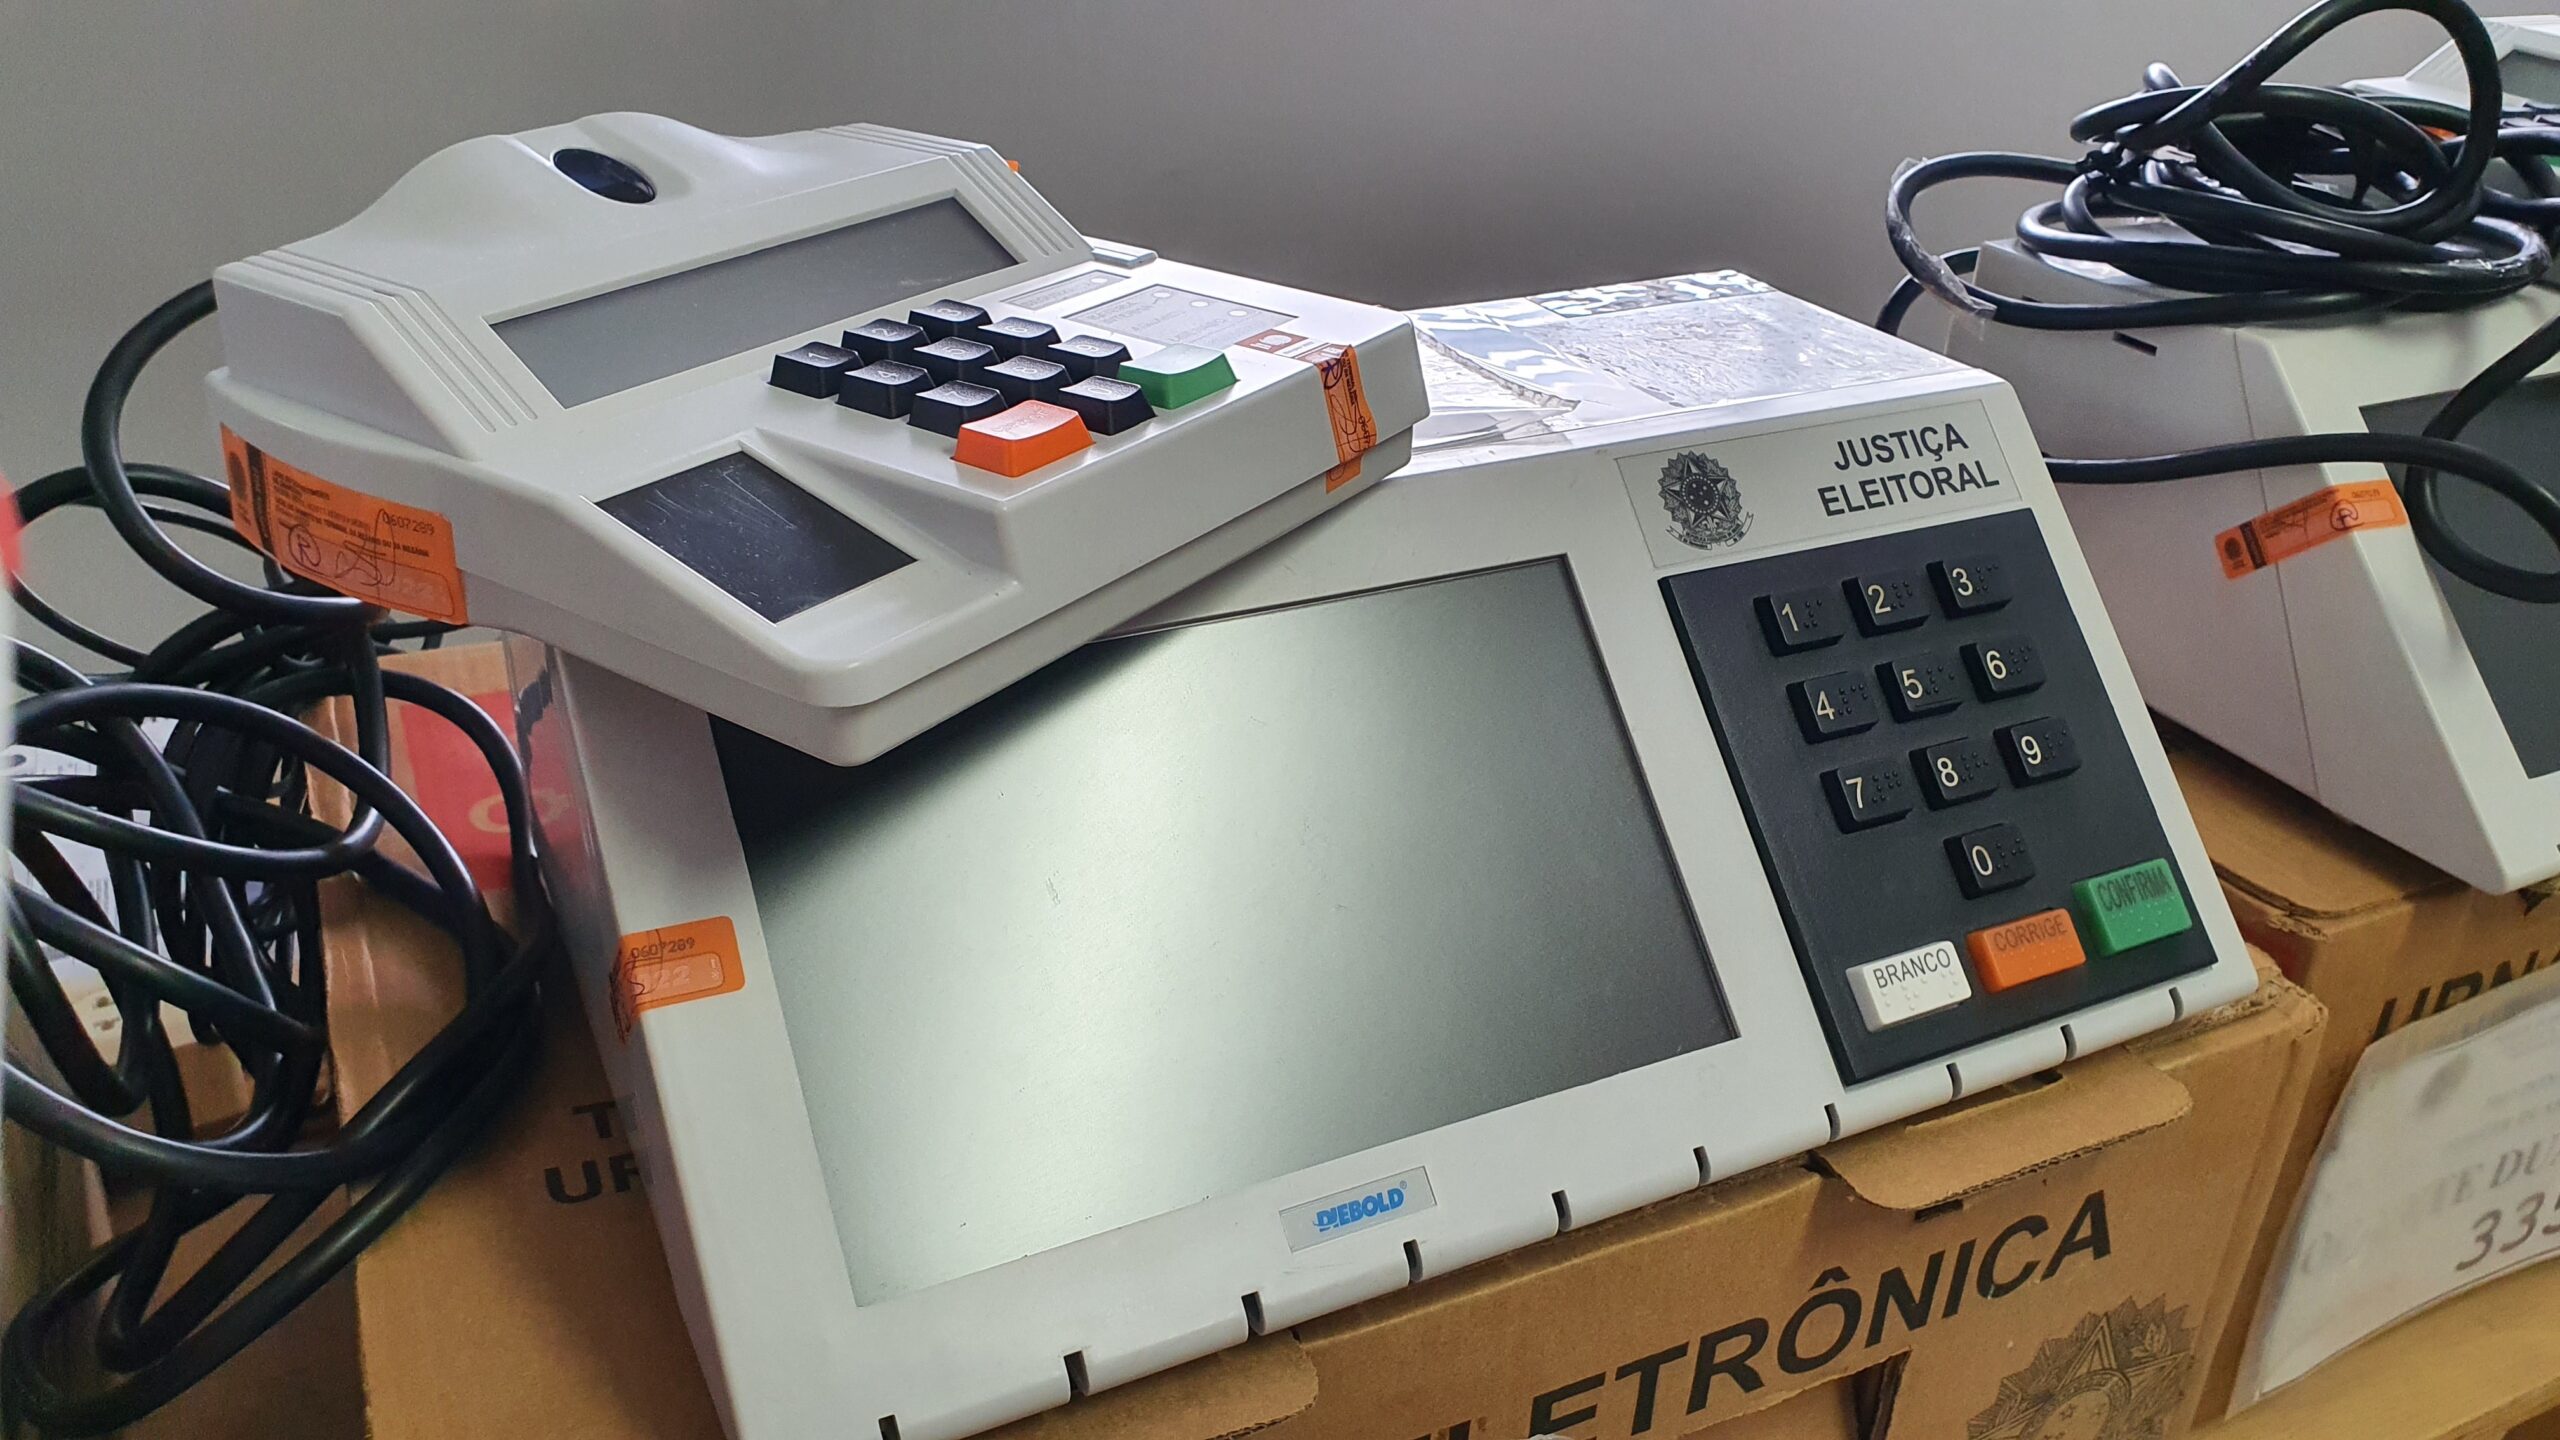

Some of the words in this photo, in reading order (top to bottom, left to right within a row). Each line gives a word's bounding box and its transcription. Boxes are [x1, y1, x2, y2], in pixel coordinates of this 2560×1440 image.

[1834, 423, 1969, 470] JUSTIÇA
[1818, 460, 2000, 516] ELEITORAL
[382, 511, 435, 536] 0607289
[1781, 602, 1799, 632] 1
[1867, 584, 1891, 615] 2
[1951, 567, 1974, 597] 3
[1815, 690, 1835, 721] 4
[1902, 669, 1923, 699] 5
[1985, 650, 2007, 680] 6
[1845, 777, 1864, 809] 7
[1936, 756, 1959, 787] 8
[2020, 735, 2042, 765] 9
[1970, 844, 1993, 876] 0
[2097, 866, 2172, 911] CONFIRMA
[631, 937, 695, 959] 0607289
[1994, 915, 2067, 952] CORRIGE
[1873, 947, 1951, 989] BRANCO
[1313, 1186, 1405, 1232] DIEBOLD
[1412, 1190, 2113, 1440] ETRÔNICA
